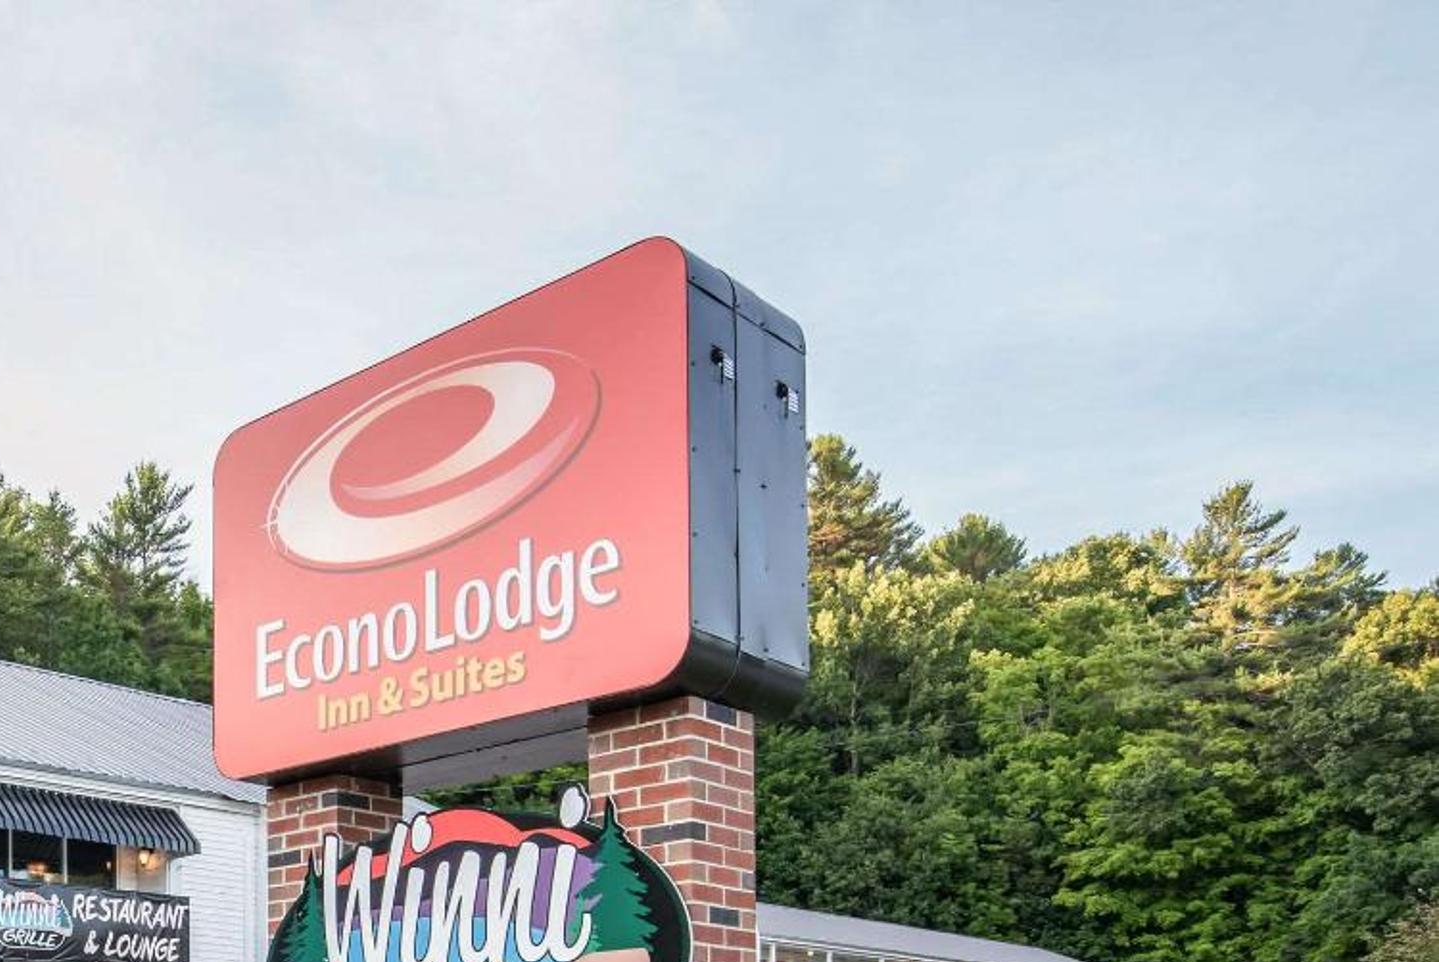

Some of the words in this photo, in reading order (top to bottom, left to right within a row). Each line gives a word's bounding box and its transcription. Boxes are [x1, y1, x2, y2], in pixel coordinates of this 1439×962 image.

[255, 537, 621, 698] EconoLodge
[317, 691, 371, 730] Inn
[378, 677, 404, 715] &
[410, 652, 527, 707] Suites
[72, 894, 189, 930] RESTAURANT
[84, 930, 101, 955] &
[104, 931, 181, 962] LOUNGE
